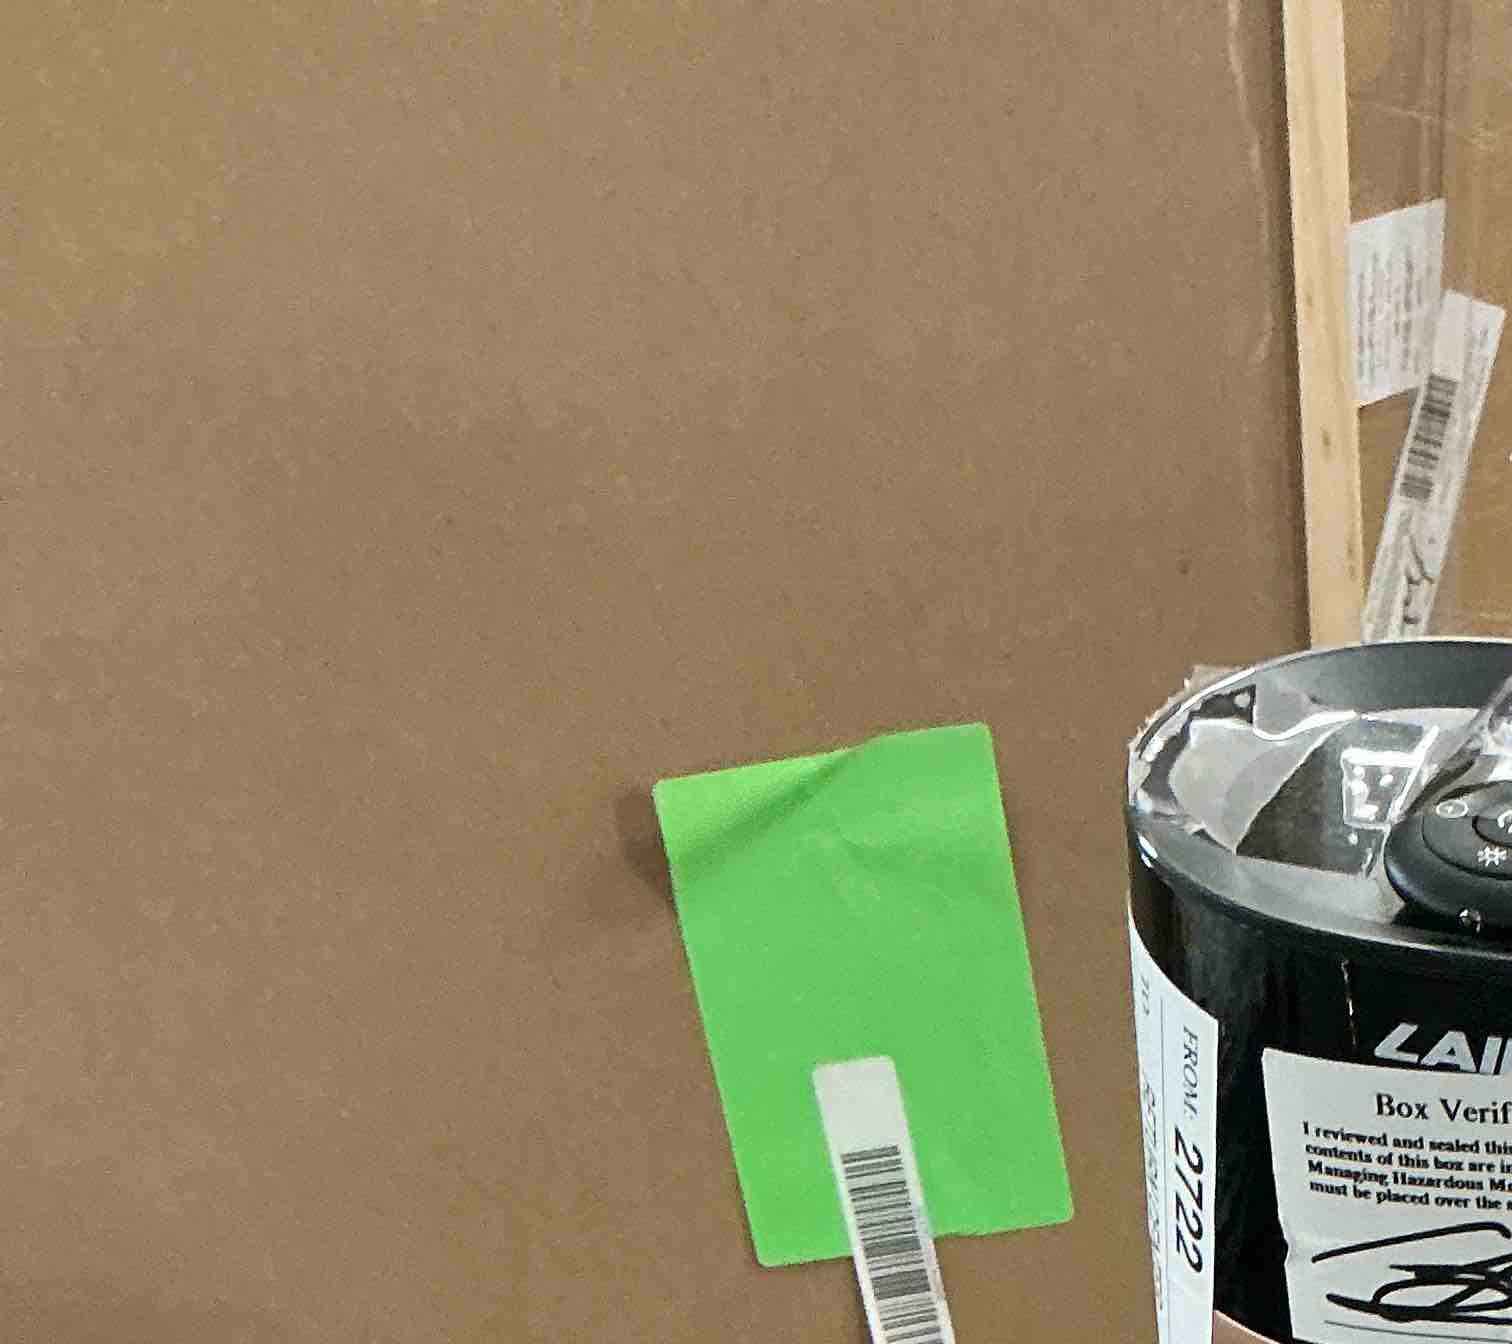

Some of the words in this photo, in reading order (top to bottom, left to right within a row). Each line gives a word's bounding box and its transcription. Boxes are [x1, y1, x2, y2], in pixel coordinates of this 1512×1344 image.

[1376, 1092, 1430, 1120] Box
[1303, 1121, 1309, 1135] I
[1315, 1126, 1388, 1147] reviewed
[1392, 1136, 1424, 1150] and
[1429, 1138, 1480, 1154] sealed
[1305, 1143, 1373, 1163] contents
[1376, 1152, 1393, 1165] of
[1398, 1153, 1430, 1169] this
[1434, 1156, 1464, 1171] box
[1468, 1161, 1496, 1173] are
[1308, 1160, 1389, 1187] Managing
[1392, 1172, 1484, 1191] Hazardous
[1174, 1127, 1205, 1273] 2722
[1310, 1181, 1348, 1197] must
[1353, 1185, 1372, 1199] be
[1376, 1189, 1430, 1204] placed
[1435, 1196, 1471, 1209] over
[1475, 1195, 1502, 1209] the
